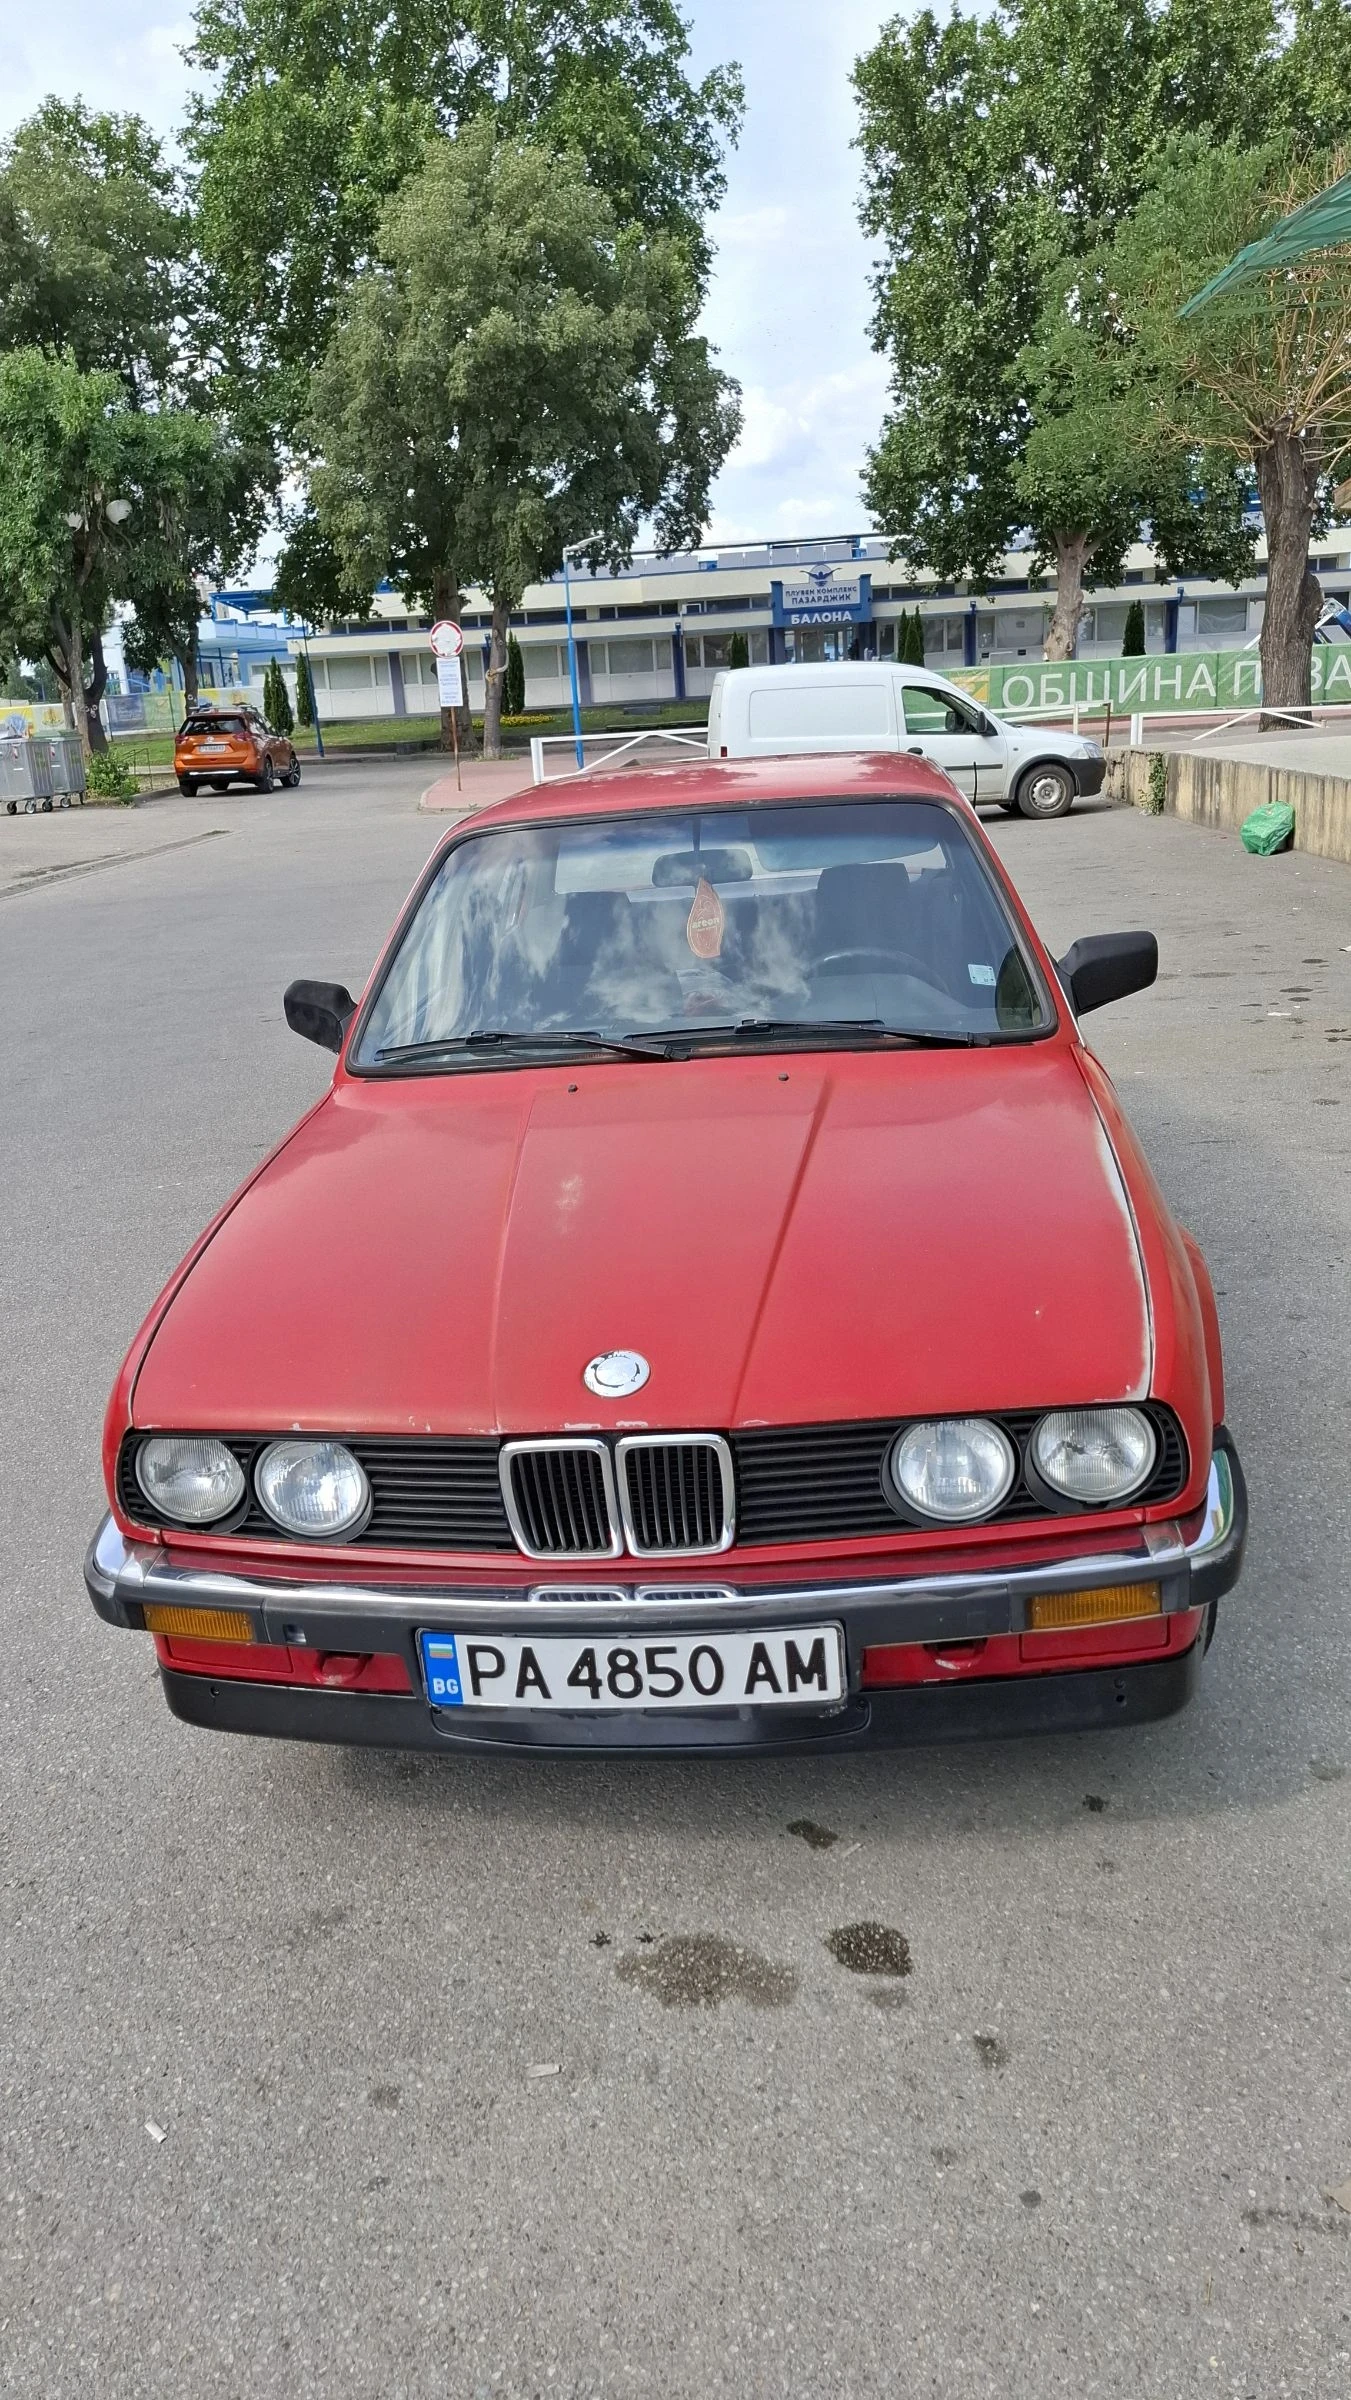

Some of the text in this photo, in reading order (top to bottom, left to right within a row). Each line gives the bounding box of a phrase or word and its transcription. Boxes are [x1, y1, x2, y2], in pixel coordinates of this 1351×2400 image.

[816, 586, 857, 595] КОМПЛЕКС
[791, 594, 851, 605] ПАЗАРДЖИК
[791, 611, 852, 625] БАЛОНА
[1002, 654, 1351, 710] ОБЩИНА ПЗА
[466, 1637, 828, 1700] PA 4850 AM
[433, 1677, 459, 1695] BG
